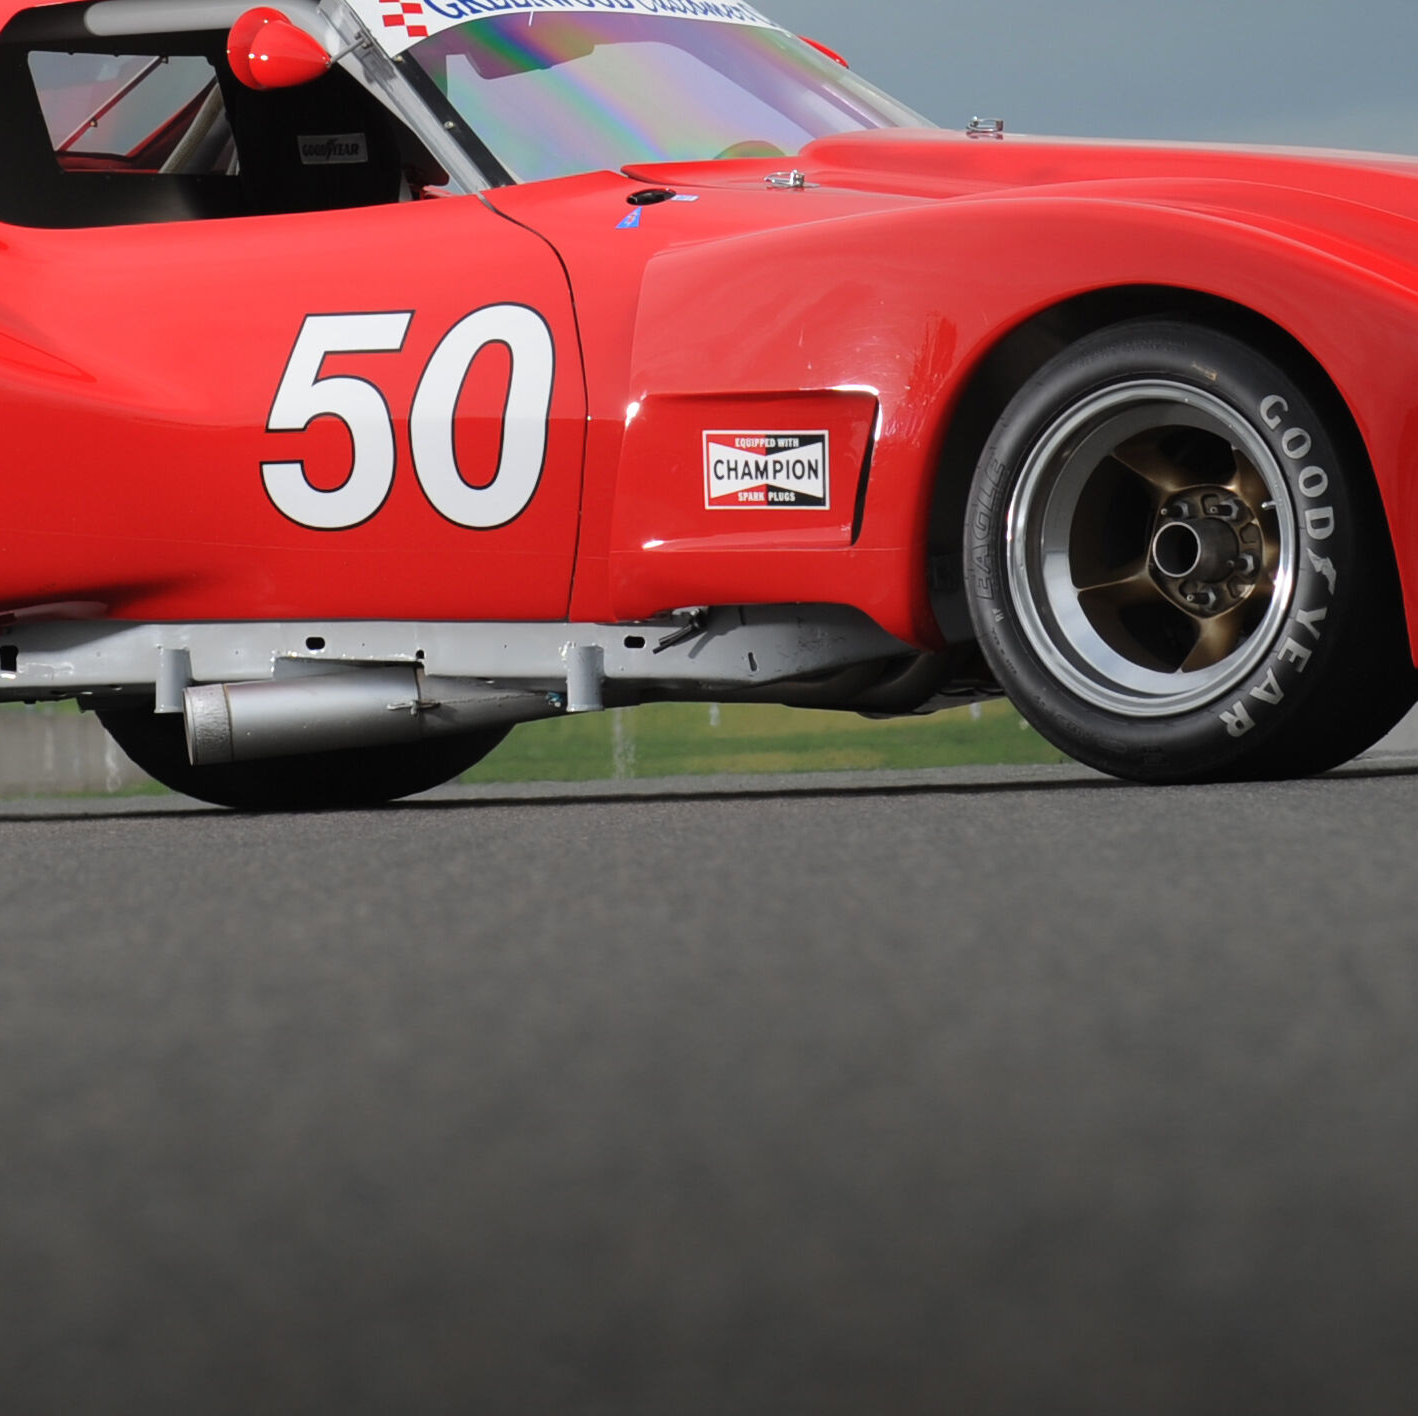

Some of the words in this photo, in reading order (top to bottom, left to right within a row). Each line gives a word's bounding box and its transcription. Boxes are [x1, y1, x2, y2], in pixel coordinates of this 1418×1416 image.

[302, 139, 359, 160] GOODYEAR
[259, 301, 557, 532] 50
[735, 437, 776, 448] EQUIPPED
[777, 437, 800, 448] WITH
[713, 458, 819, 481] CHAMPION
[737, 491, 765, 502] SPARK
[768, 491, 796, 502] PLUGS
[1219, 394, 1337, 738] GOODYEAR
